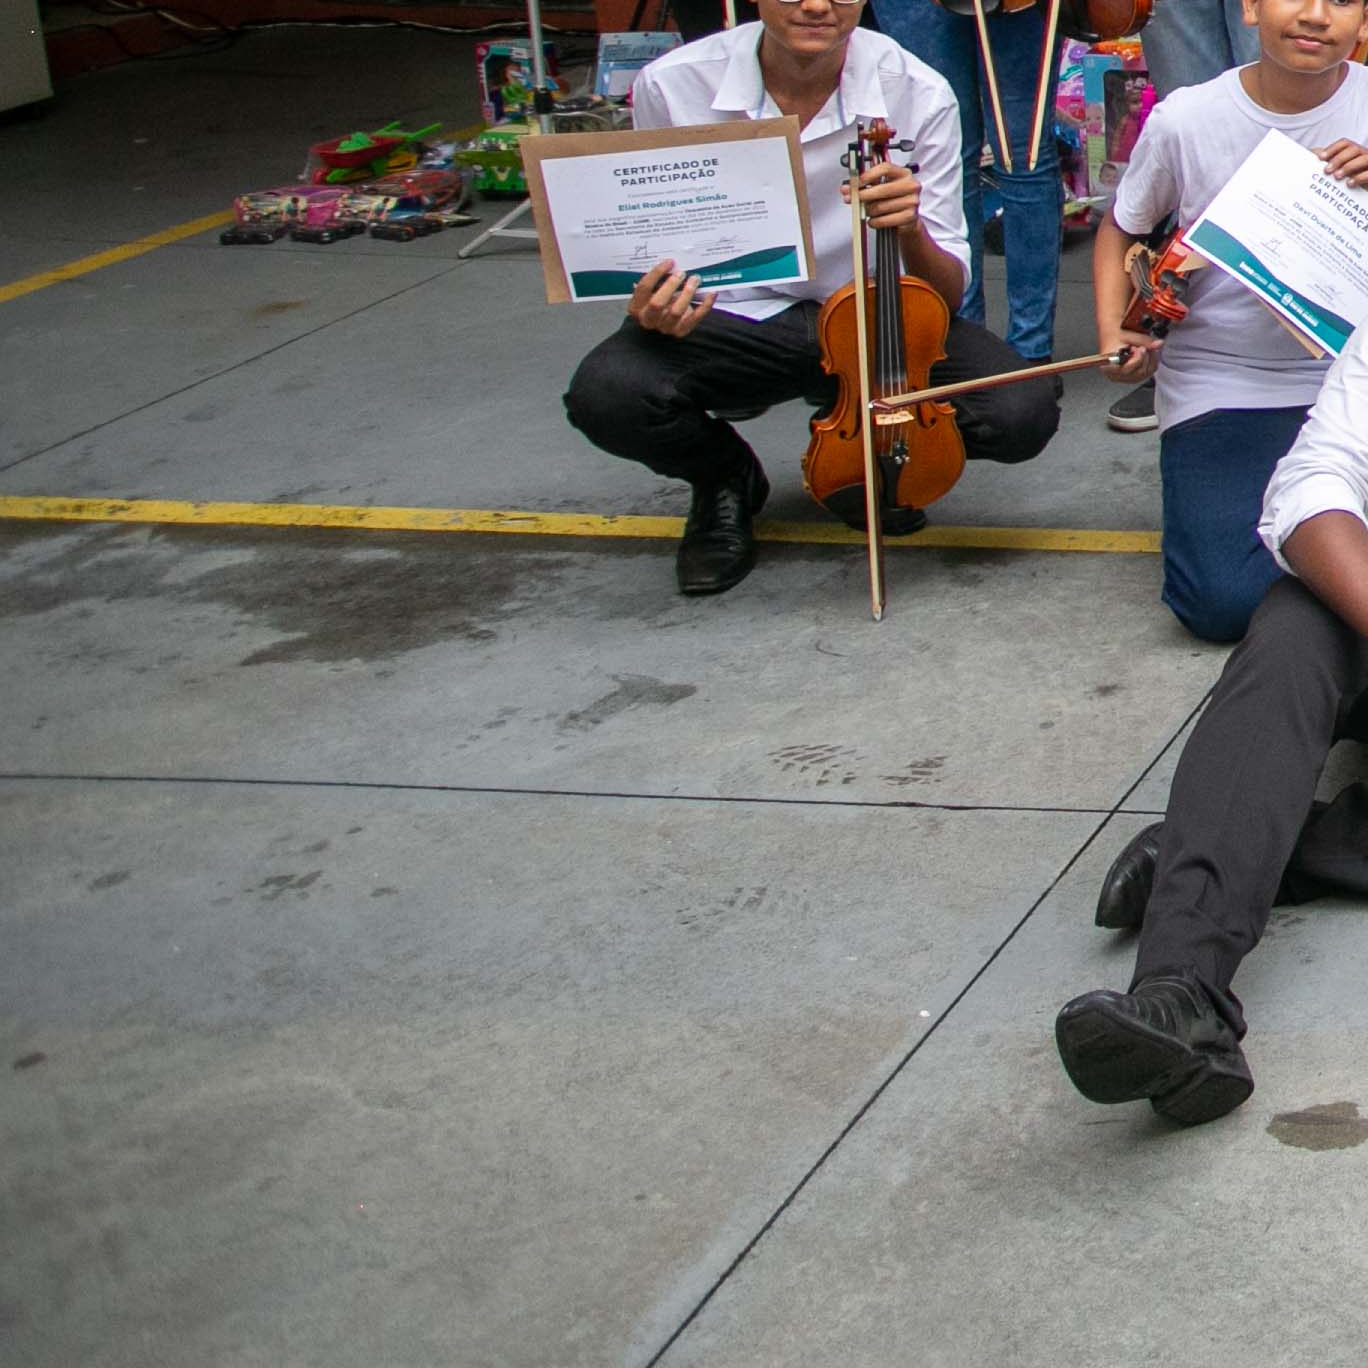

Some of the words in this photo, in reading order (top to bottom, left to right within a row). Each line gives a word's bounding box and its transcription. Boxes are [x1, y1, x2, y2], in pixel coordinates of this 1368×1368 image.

[613, 159, 700, 177] CERTIFICADO
[703, 157, 719, 167] DE
[621, 168, 715, 187] PARTICIPAÇÃO
[643, 198, 694, 210] Rodrigues
[696, 192, 728, 203] Simão
